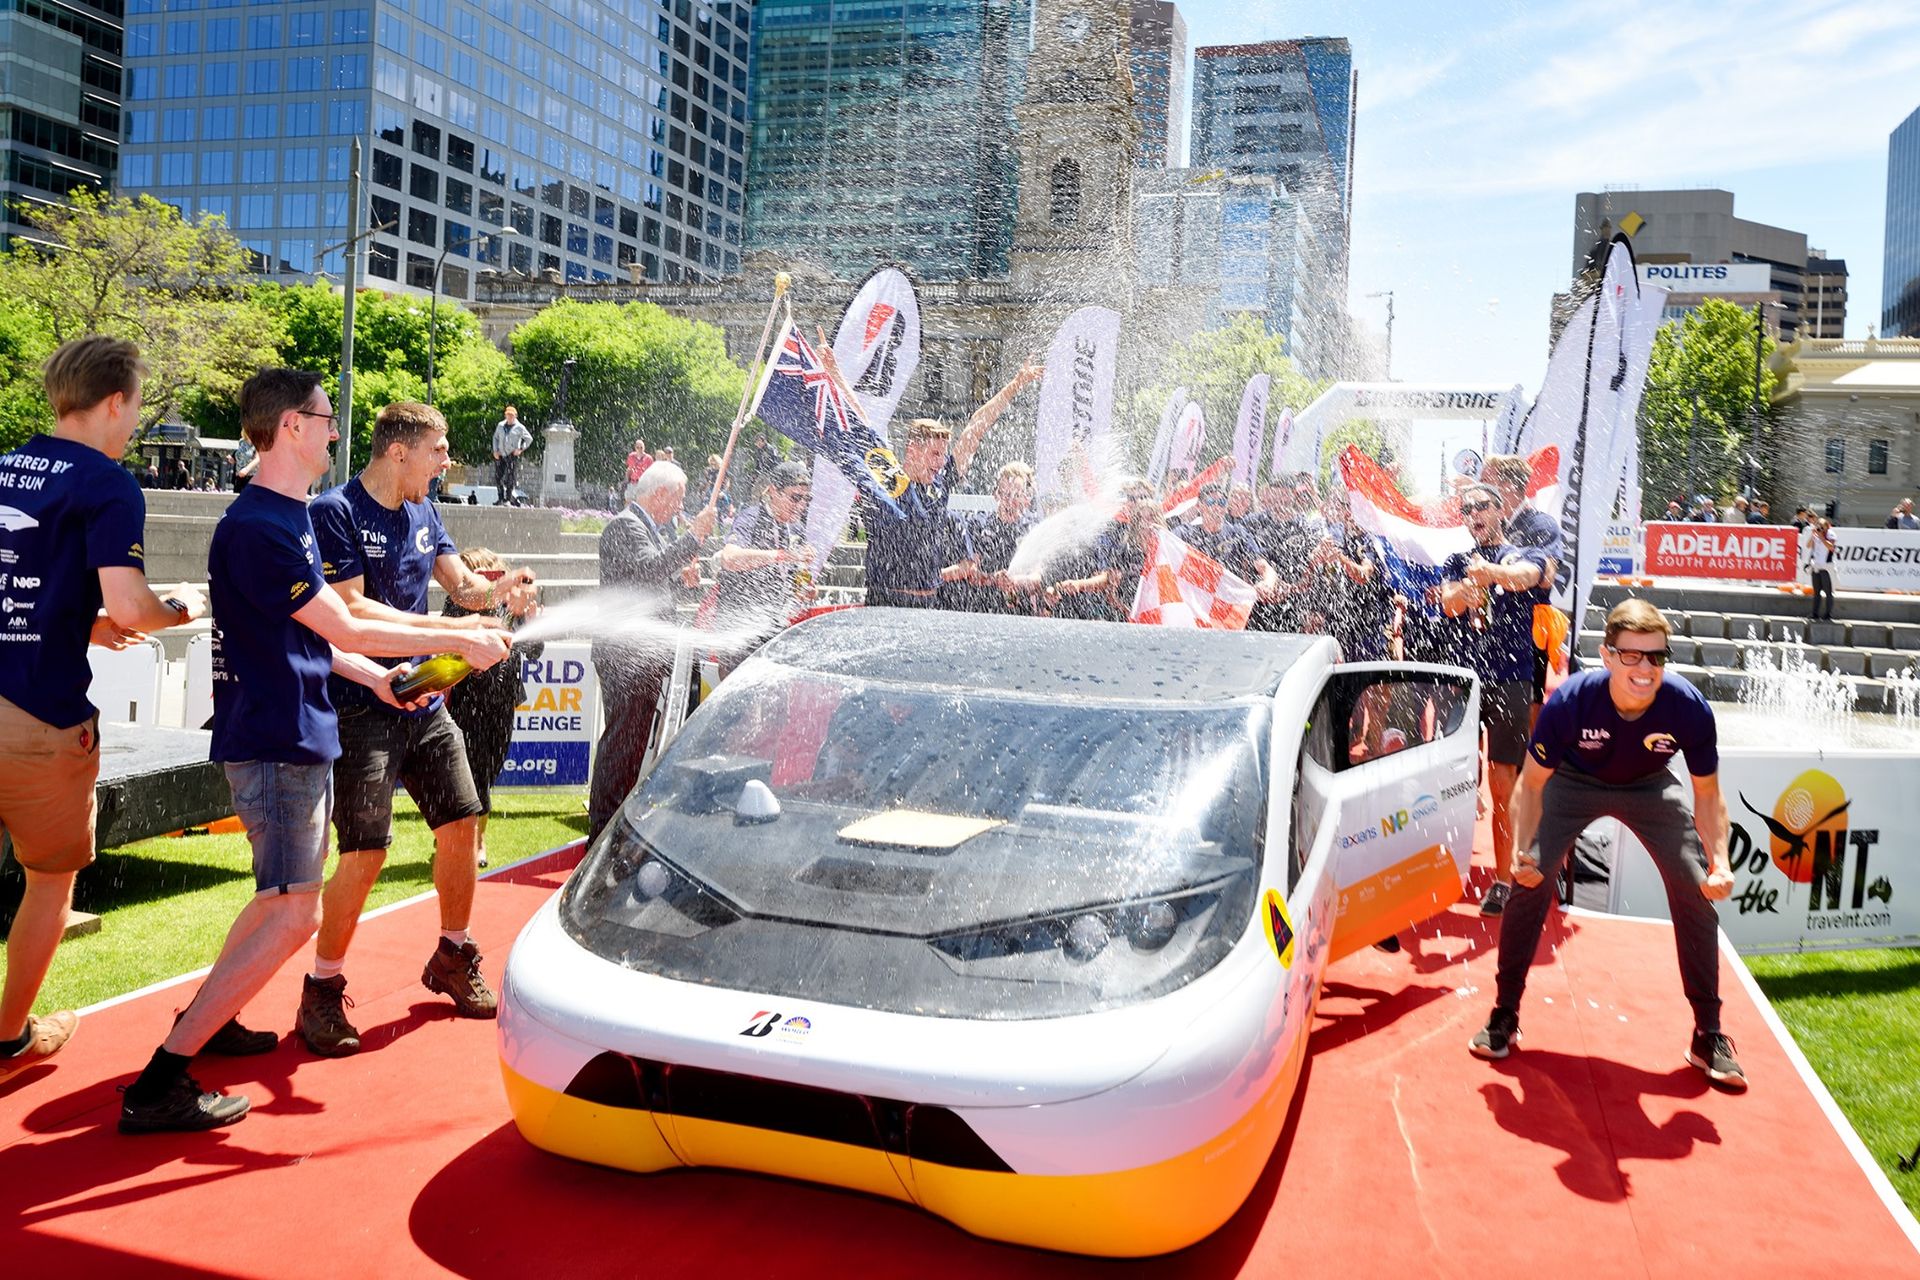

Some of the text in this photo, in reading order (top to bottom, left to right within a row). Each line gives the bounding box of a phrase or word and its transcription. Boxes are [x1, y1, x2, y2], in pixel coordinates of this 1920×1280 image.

[1647, 266, 1728, 279] POLITES
[51, 460, 74, 473] BY
[17, 475, 46, 490] SUN
[1657, 533, 1786, 560] ADELAIDE
[1657, 555, 1785, 571] SOUTH AUSTRALIA
[13, 576, 41, 589] NXP
[522, 659, 585, 683] RLD
[503, 758, 557, 774] e.org
[1729, 821, 1769, 874] Do
[1809, 830, 1880, 912] NT
[1732, 879, 1780, 915] the
